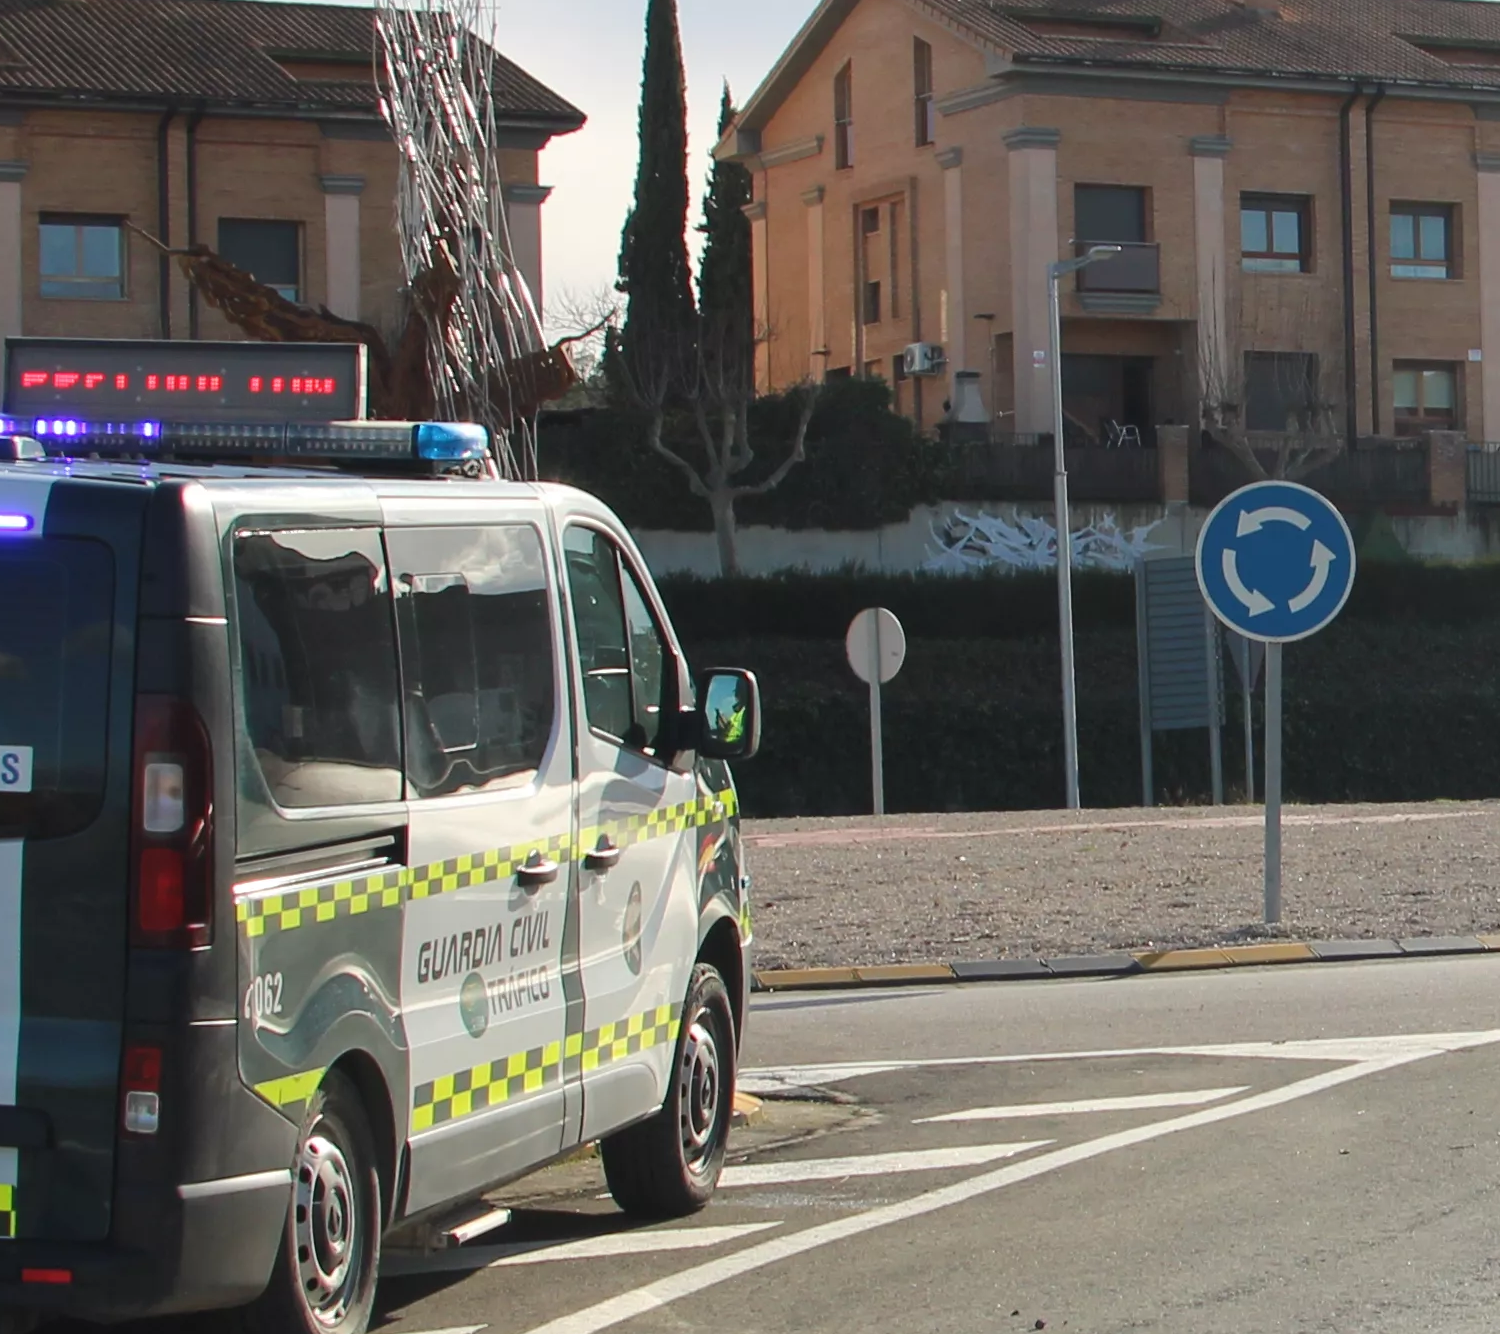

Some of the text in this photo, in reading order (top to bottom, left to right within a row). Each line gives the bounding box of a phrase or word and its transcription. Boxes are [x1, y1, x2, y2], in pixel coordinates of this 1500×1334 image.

[417, 910, 550, 984] GUARDIA CIVIL
[254, 971, 283, 1017] 062
[487, 964, 550, 1015] TRÁFICO
